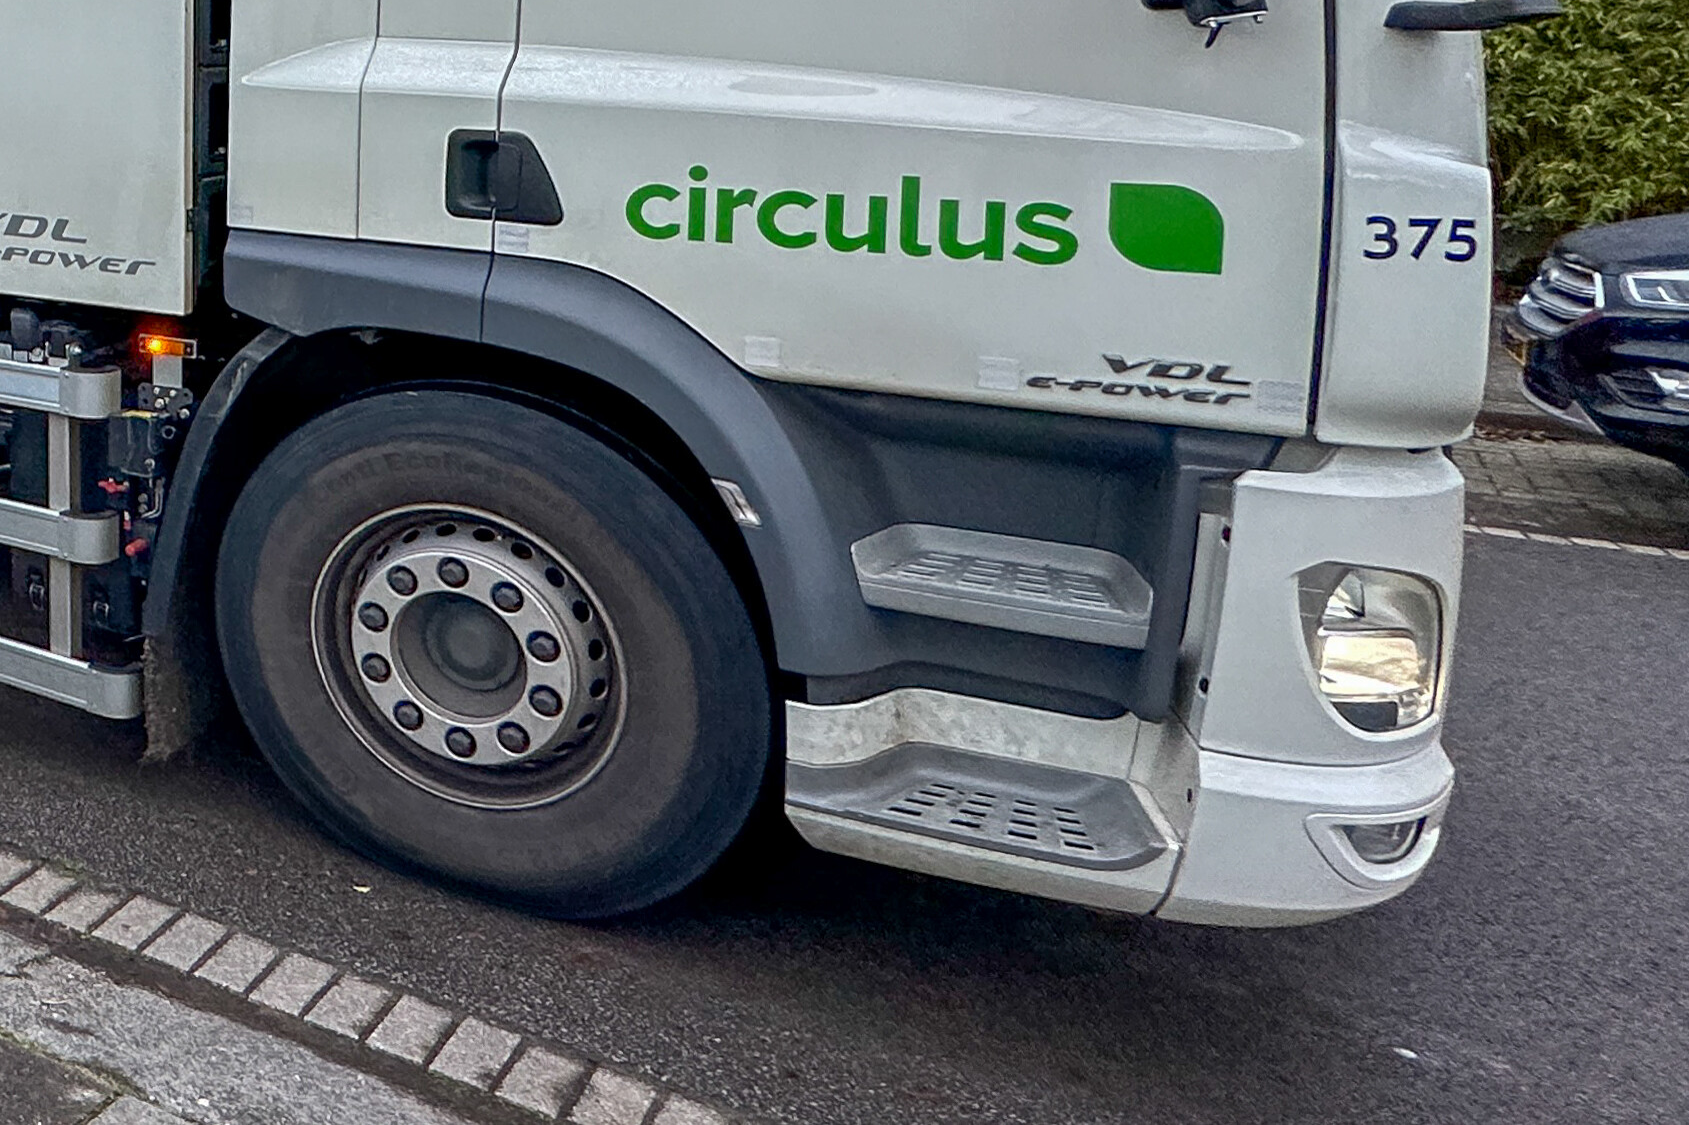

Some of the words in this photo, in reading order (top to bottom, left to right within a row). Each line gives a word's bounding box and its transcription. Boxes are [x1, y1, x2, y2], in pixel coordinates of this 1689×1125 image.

[625, 165, 1080, 265] circulus
[1363, 216, 1477, 262] 375
[1102, 354, 1251, 385] VDL
